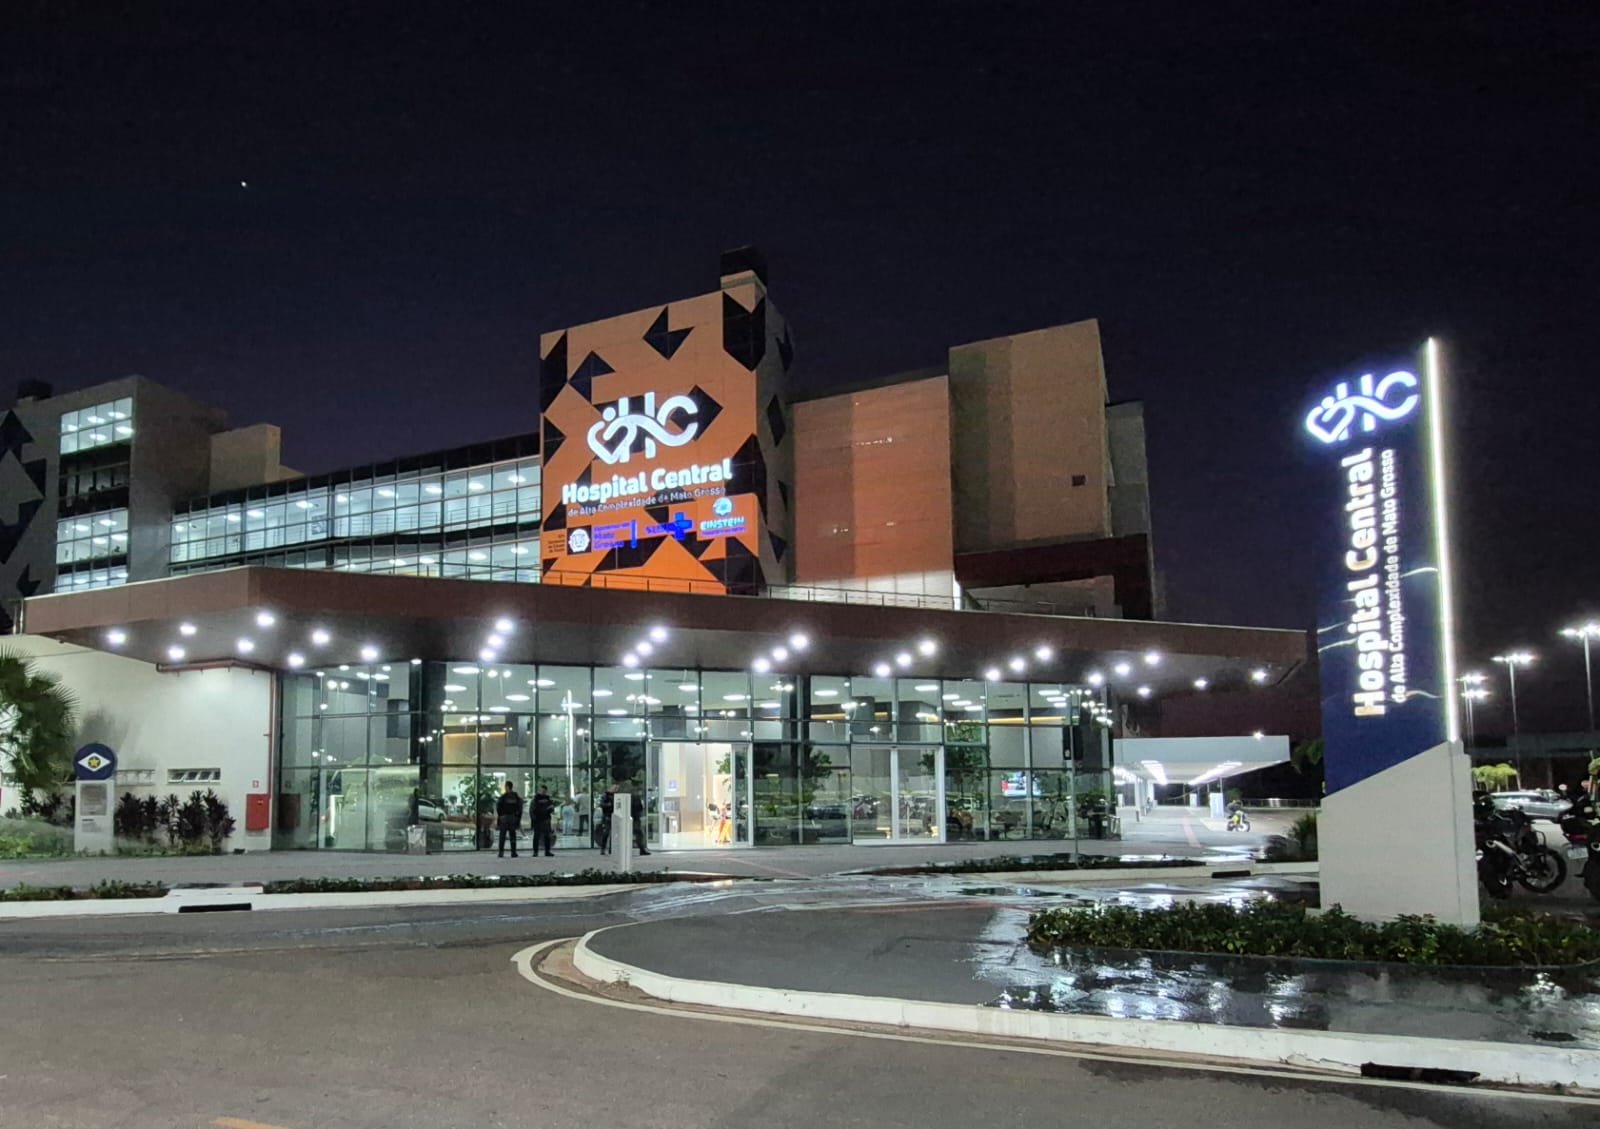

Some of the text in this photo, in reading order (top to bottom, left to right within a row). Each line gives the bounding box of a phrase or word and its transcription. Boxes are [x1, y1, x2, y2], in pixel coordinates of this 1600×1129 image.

[562, 458, 733, 505] Hospital Central
[580, 505, 597, 515] Alta
[700, 517, 745, 531] EINSTEIN
[1341, 447, 1389, 716] Hospital Central
[1380, 449, 1407, 703] de Alta Complexidade de Mato Grosso
